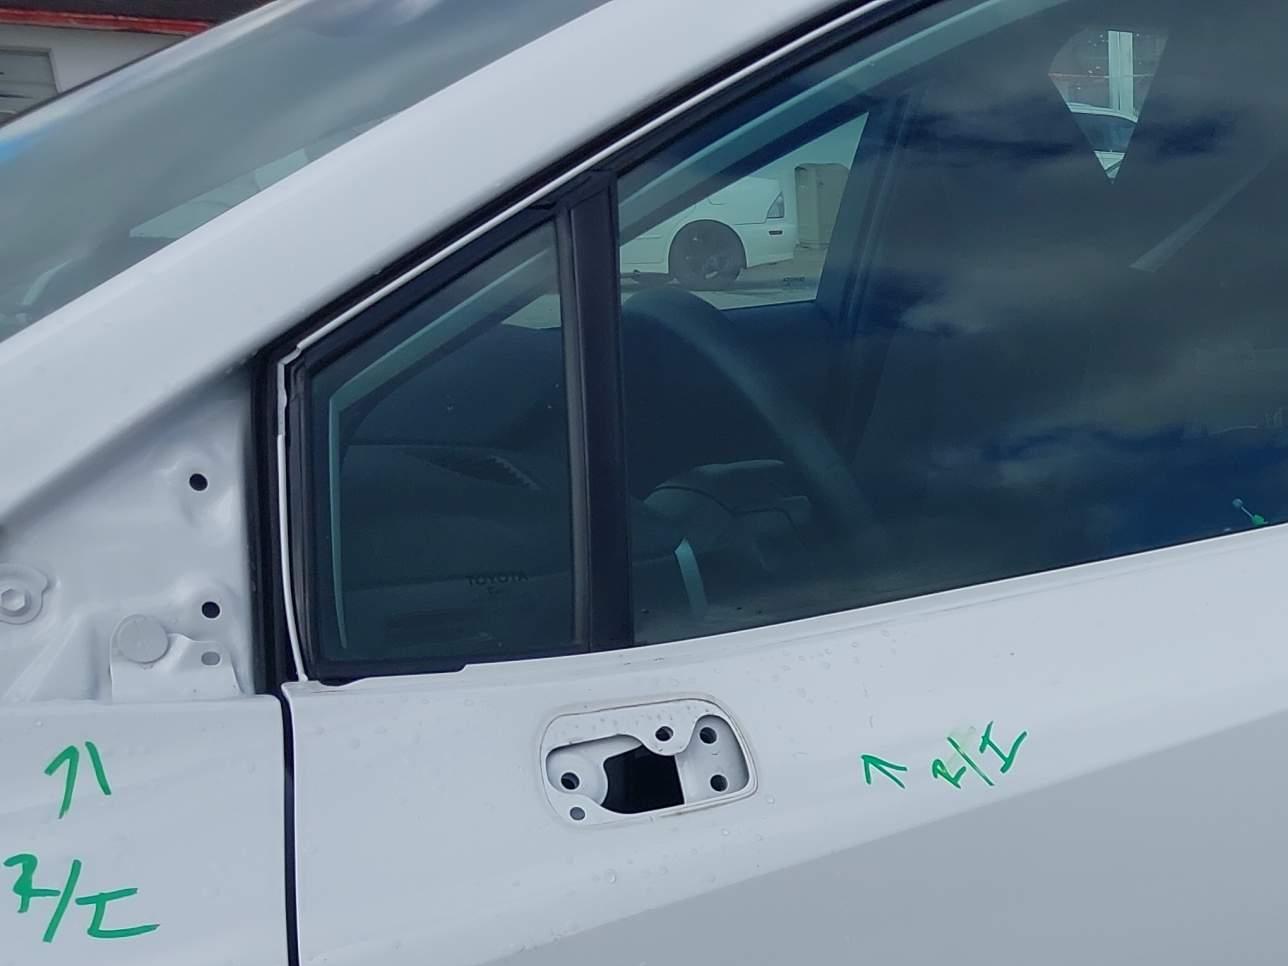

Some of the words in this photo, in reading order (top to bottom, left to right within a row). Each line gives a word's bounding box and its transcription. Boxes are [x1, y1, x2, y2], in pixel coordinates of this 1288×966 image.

[464, 572, 529, 587] TOYOTA
[931, 720, 1028, 790] R/I
[3, 852, 161, 944] R/I
